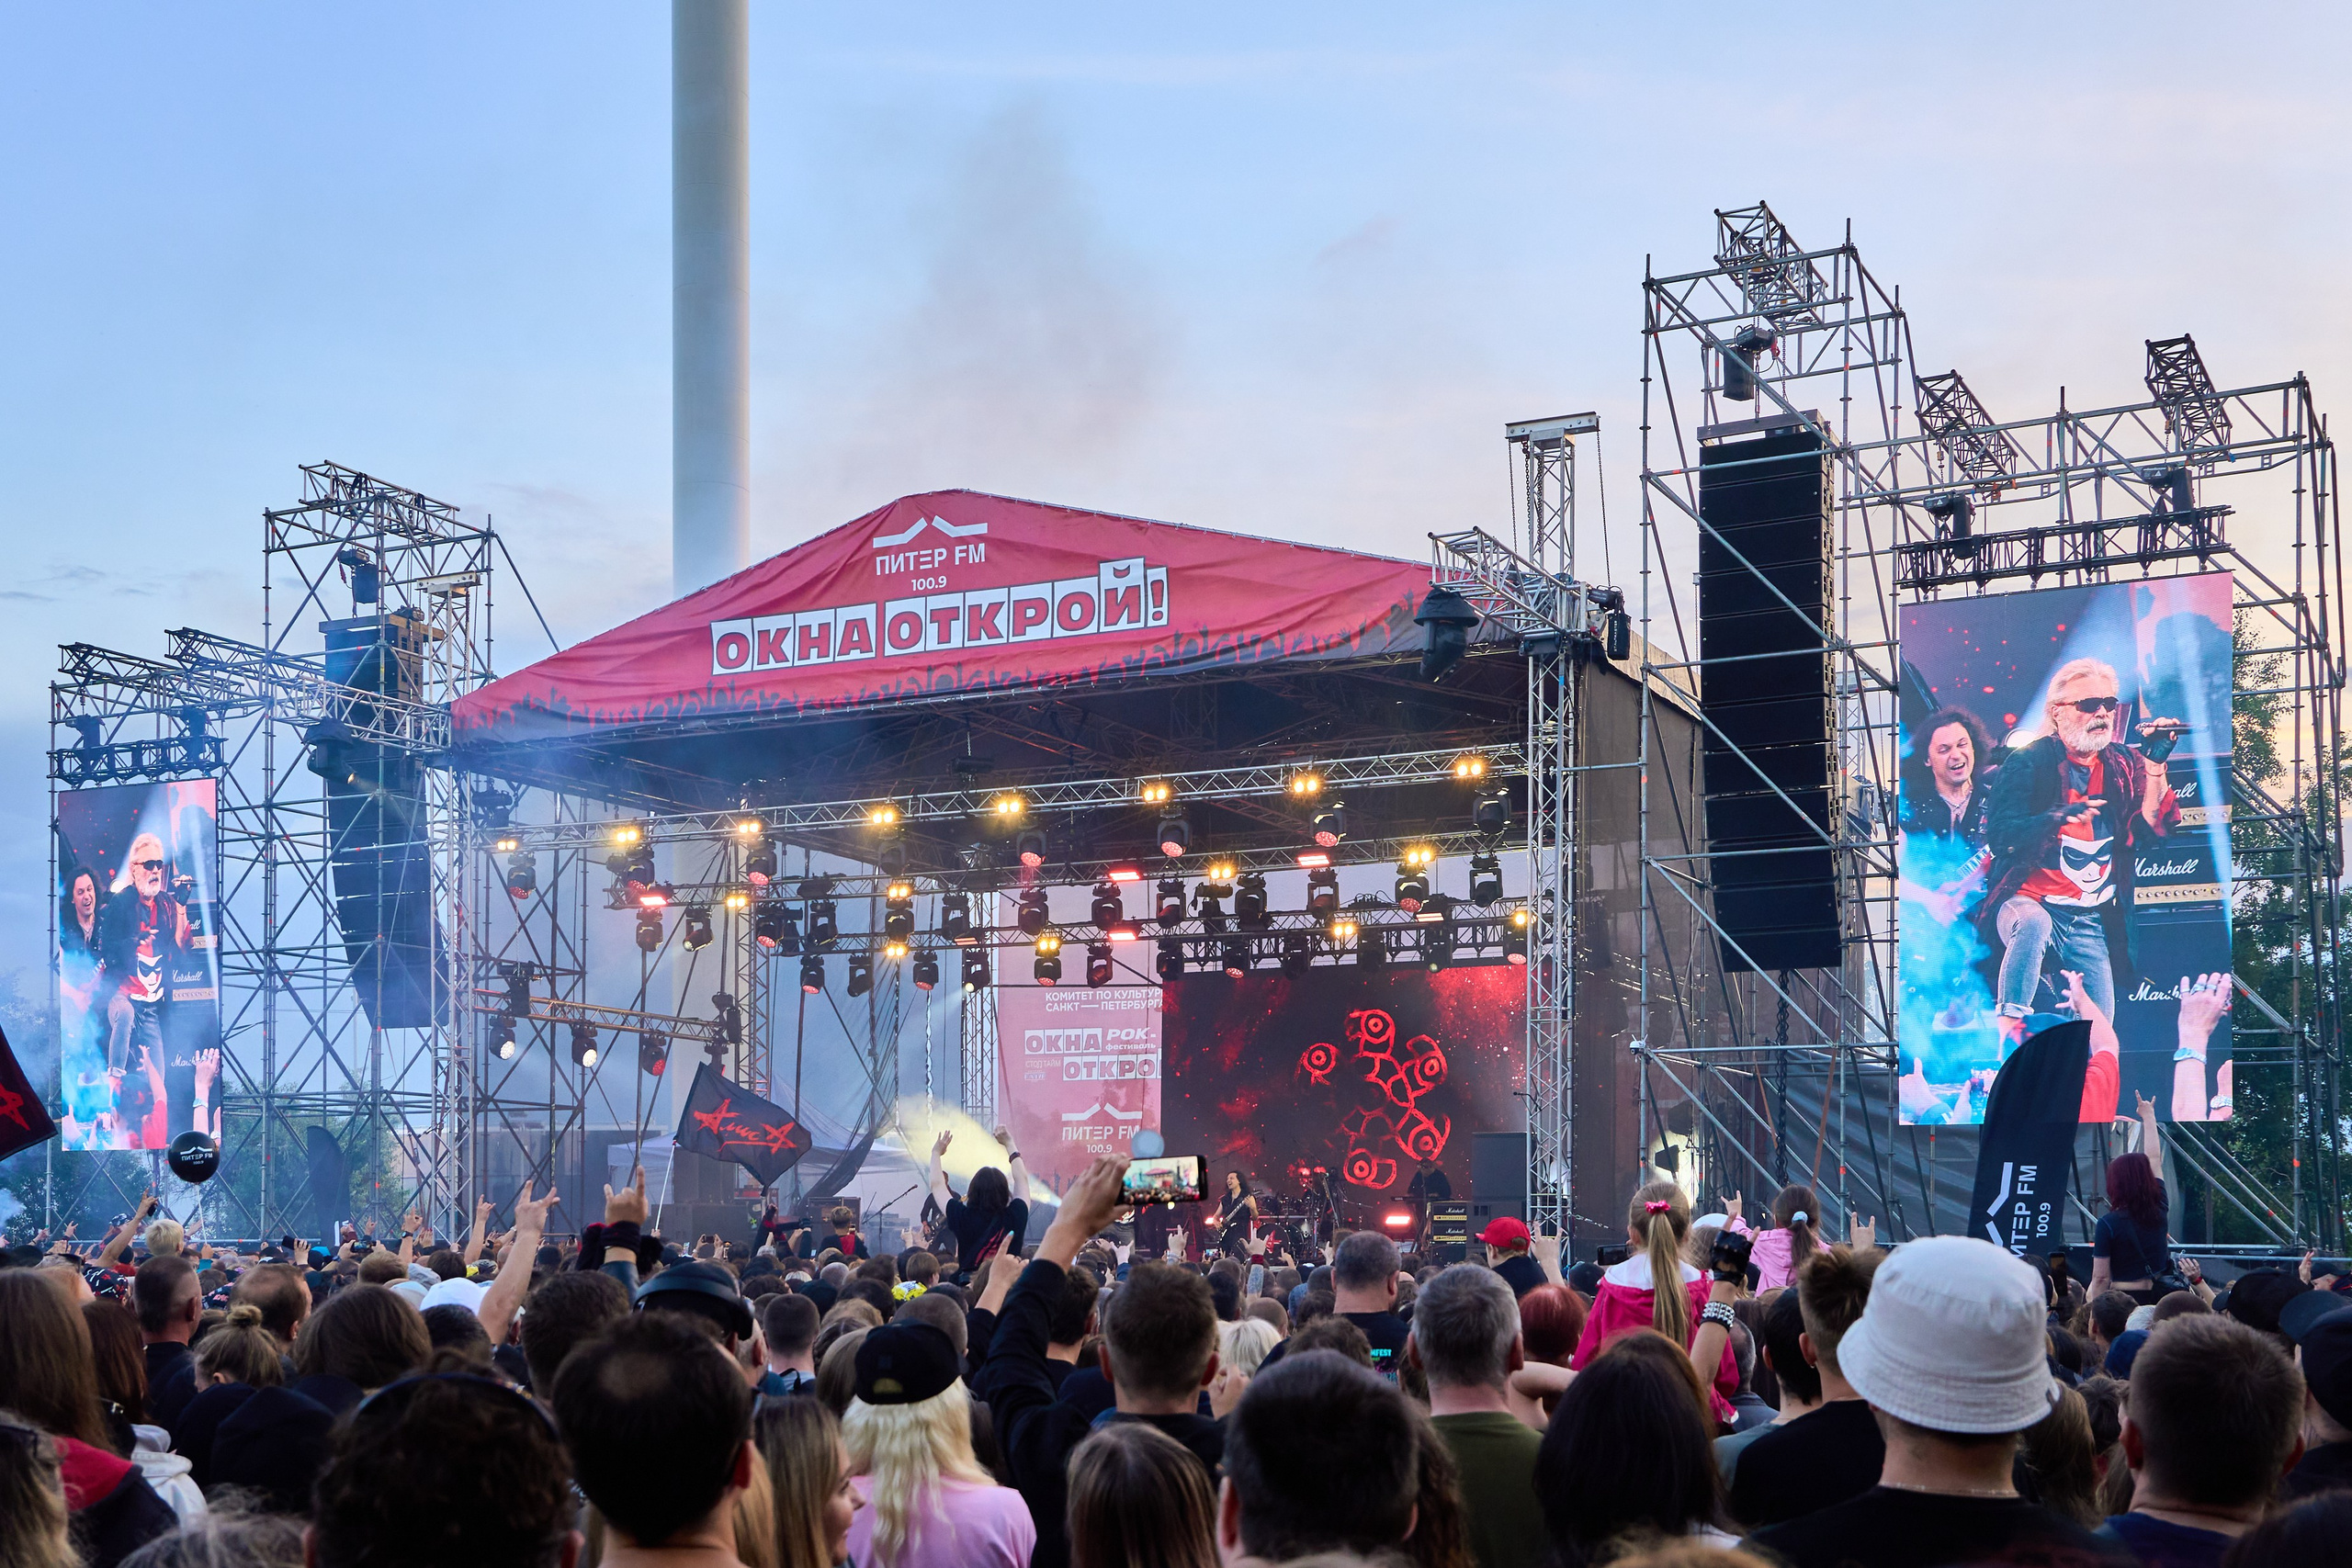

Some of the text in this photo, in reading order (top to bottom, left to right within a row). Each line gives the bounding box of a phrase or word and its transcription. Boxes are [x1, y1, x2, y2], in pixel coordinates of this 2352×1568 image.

[876, 543, 985, 576] ПИТЕР FM
[911, 576, 947, 591] 100.9
[714, 561, 1167, 672] ОКНА ОТКРОЙ!
[1046, 988, 1162, 1001] КОМИТЕТ ПО КУЛЬТУР
[1046, 1002, 1080, 1011] САНКТ
[1024, 1028, 1157, 1054] ОКНА РОК-
[1105, 1043, 1157, 1052] фестиваль
[1063, 1054, 1161, 1080] ОТКРО
[1062, 1125, 1139, 1140] ПИТЕР FM
[1087, 1145, 1113, 1153] 100.9
[2010, 1166, 2037, 1258] ИТЕР FM
[2036, 1202, 2051, 1238] 100.9
